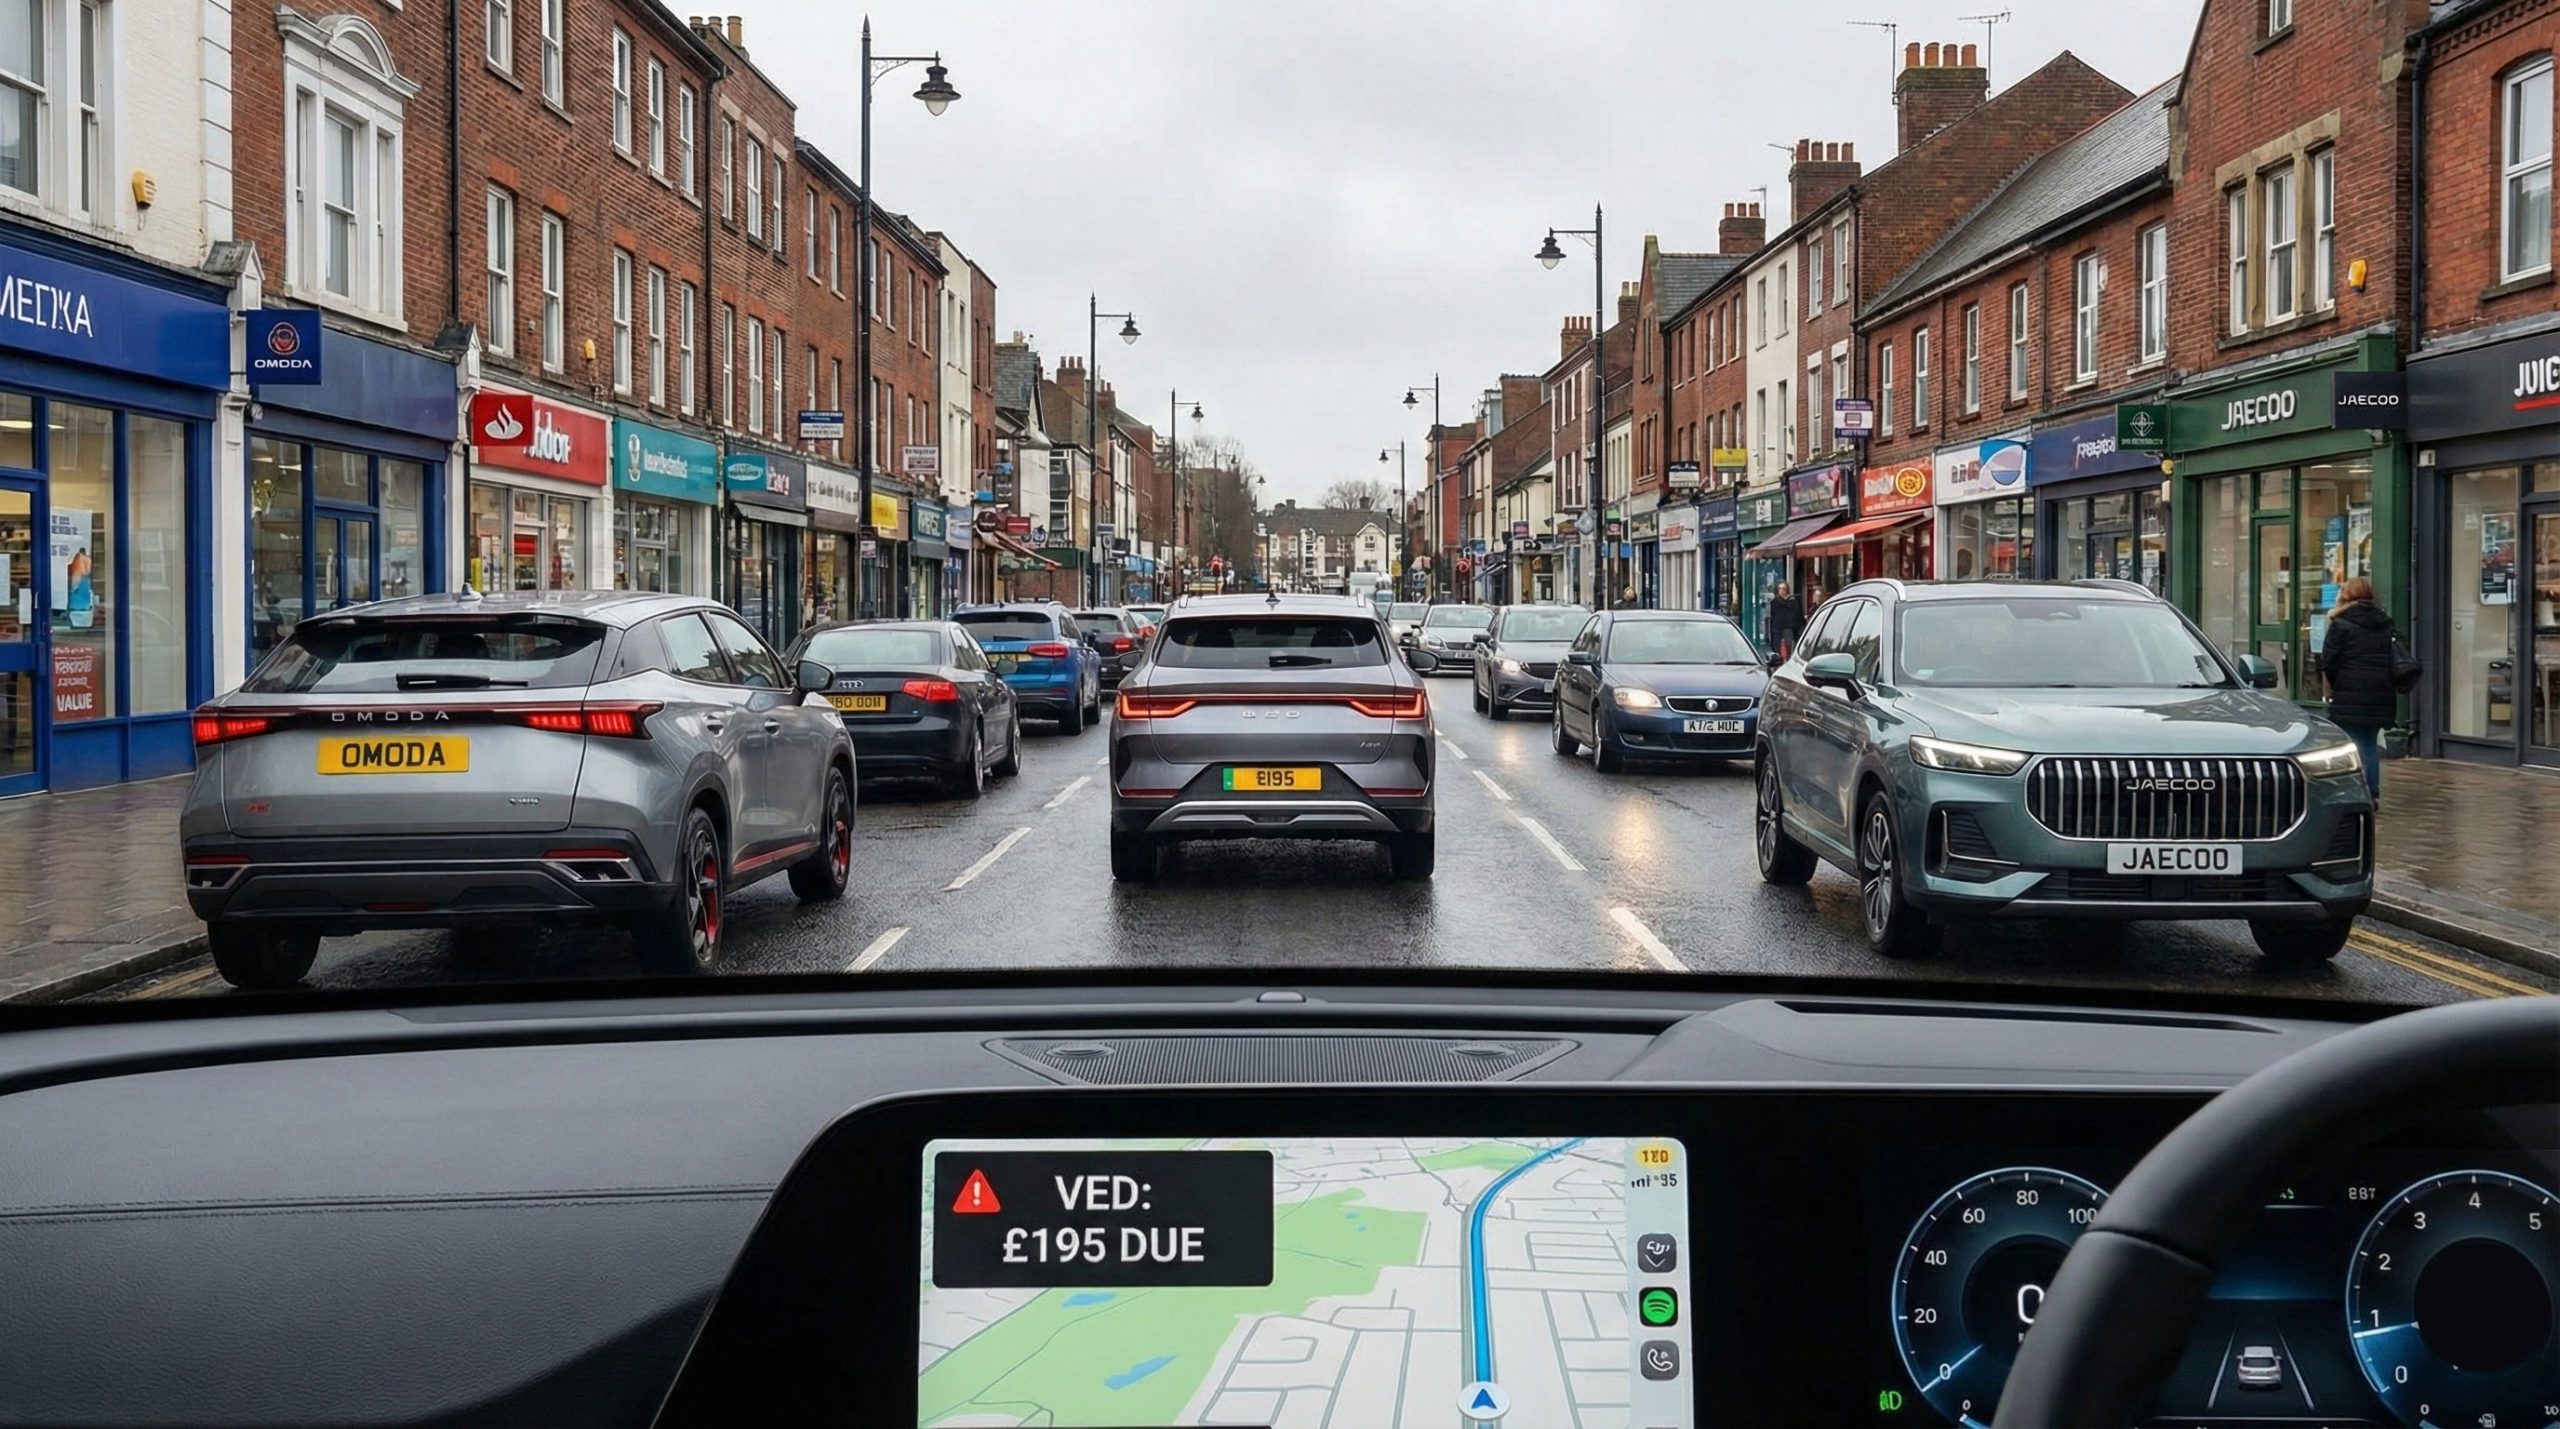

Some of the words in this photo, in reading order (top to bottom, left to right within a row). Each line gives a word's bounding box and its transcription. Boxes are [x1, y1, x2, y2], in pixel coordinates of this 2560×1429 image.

[254, 359, 312, 369] OMODA
[2338, 394, 2399, 406] JAECOO
[2221, 389, 2297, 431] JAECOO
[331, 711, 450, 722] OMODA
[341, 742, 446, 768] OMODA
[2126, 779, 2216, 791] JAECOO
[2122, 848, 2229, 871] JAECOO
[1054, 1175, 1152, 1210] VED:
[2016, 1190, 2039, 1206] 80
[2469, 1192, 2482, 1209] 4
[1962, 1208, 1985, 1223] 60
[2068, 1208, 2098, 1224] 100
[2414, 1212, 2426, 1229] 3
[2529, 1213, 2542, 1230] 5
[1003, 1227, 1106, 1263] £195
[1121, 1227, 1205, 1263] DUE
[1924, 1250, 1947, 1266] 40
[2378, 1253, 2391, 1270] 2
[1914, 1308, 1937, 1323] 20
[2370, 1309, 2379, 1327] 1
[1939, 1363, 1951, 1380] 0
[2395, 1366, 2408, 1383] 0
[1962, 1400, 1971, 1411] 0
[2420, 1404, 2430, 1415] 0
